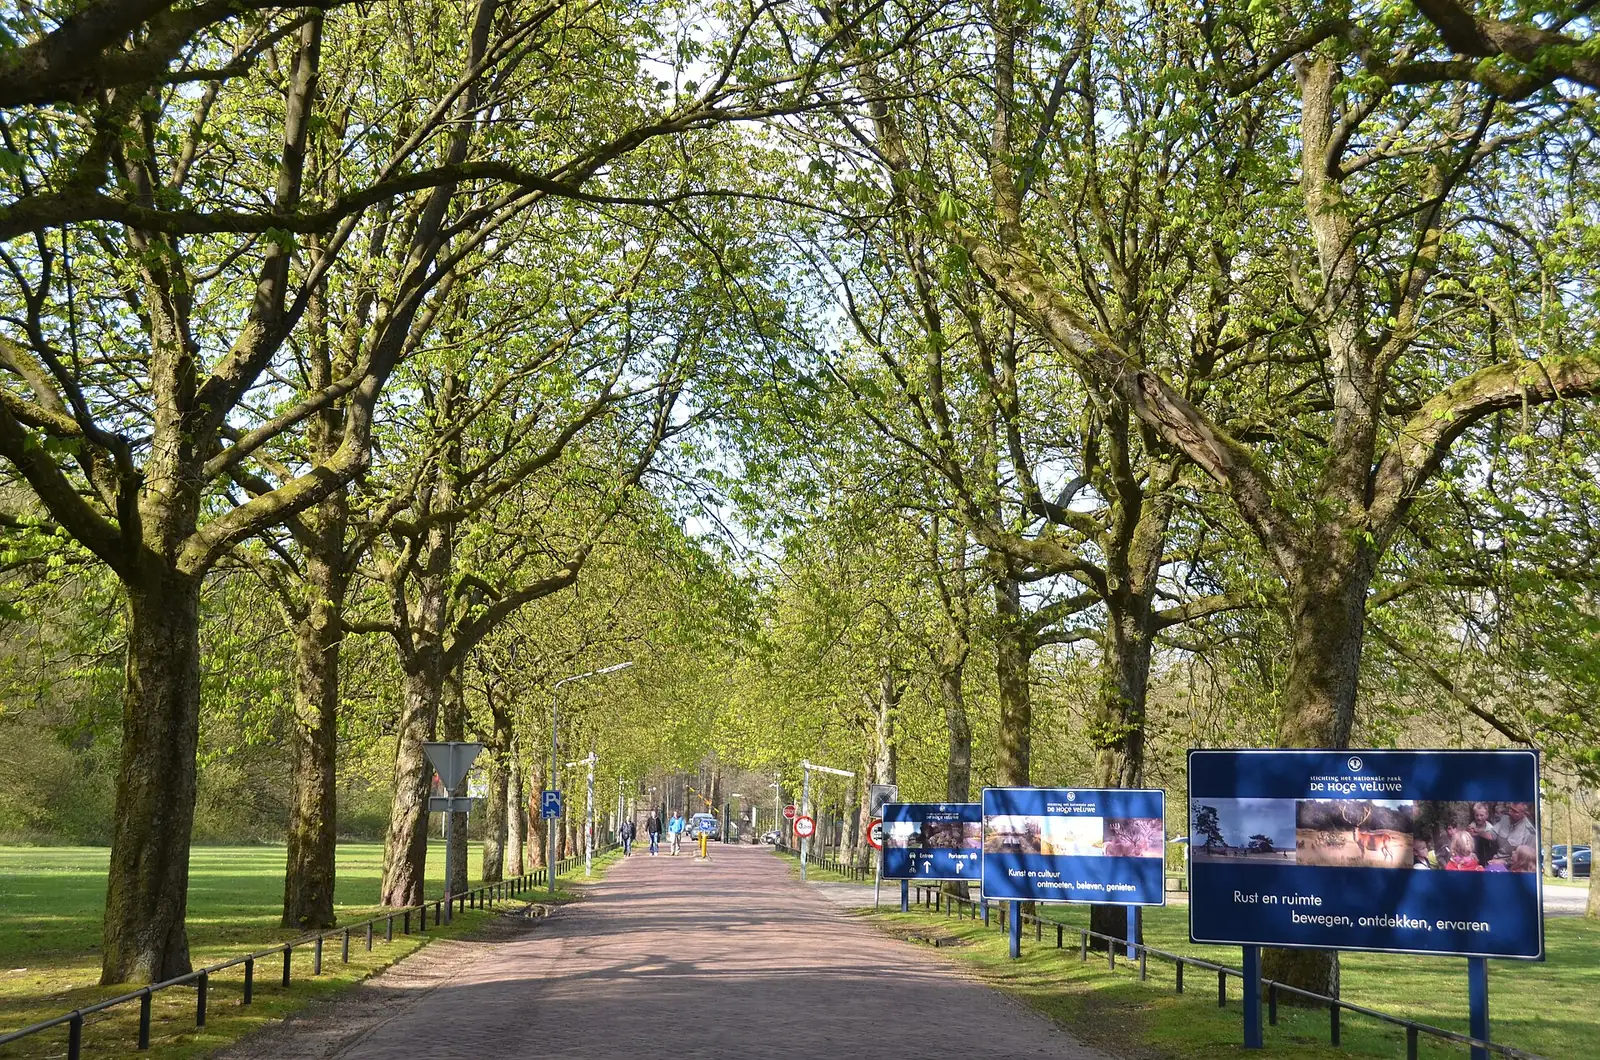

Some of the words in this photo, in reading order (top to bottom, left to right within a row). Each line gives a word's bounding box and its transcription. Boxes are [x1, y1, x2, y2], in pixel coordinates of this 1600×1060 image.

[1008, 868, 1026, 877] Kunst
[1037, 869, 1061, 878] cultuur
[1106, 882, 1136, 893] genieten
[1234, 890, 1259, 903] Rust
[1262, 893, 1278, 904] en
[1282, 893, 1323, 906] ruimte
[1291, 910, 1354, 928] bewegen,
[1358, 914, 1433, 931] ontdekken,
[1436, 919, 1490, 932] ervaren
